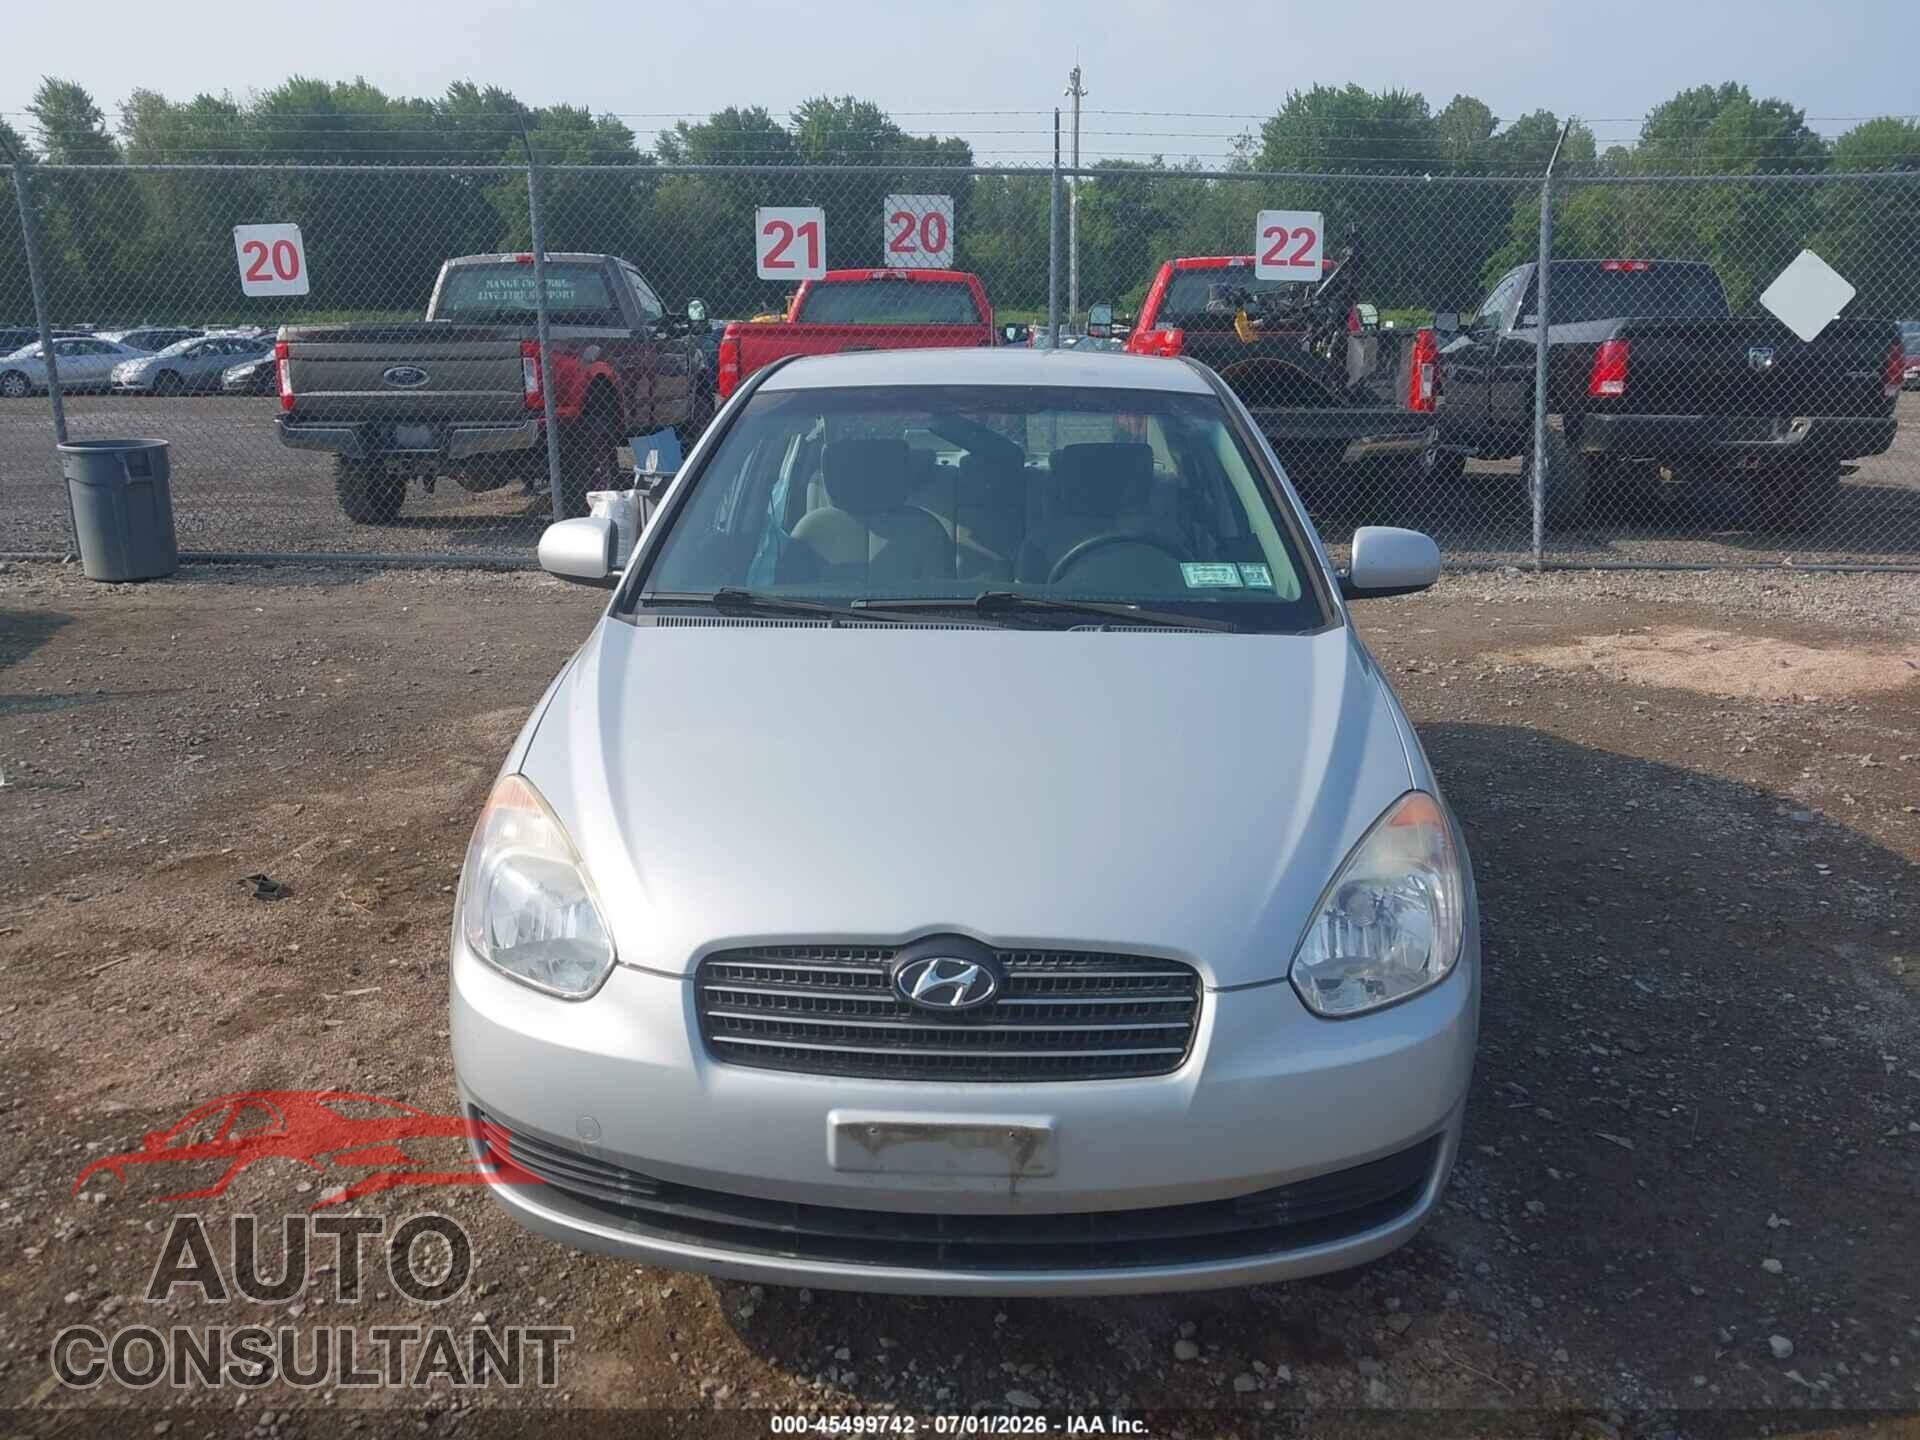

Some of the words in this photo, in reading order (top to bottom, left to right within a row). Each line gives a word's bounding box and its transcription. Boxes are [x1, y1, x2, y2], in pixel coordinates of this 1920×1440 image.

[762, 220, 819, 269] 21
[889, 211, 947, 253] 20
[1261, 226, 1317, 267] 22
[242, 239, 299, 282] 20
